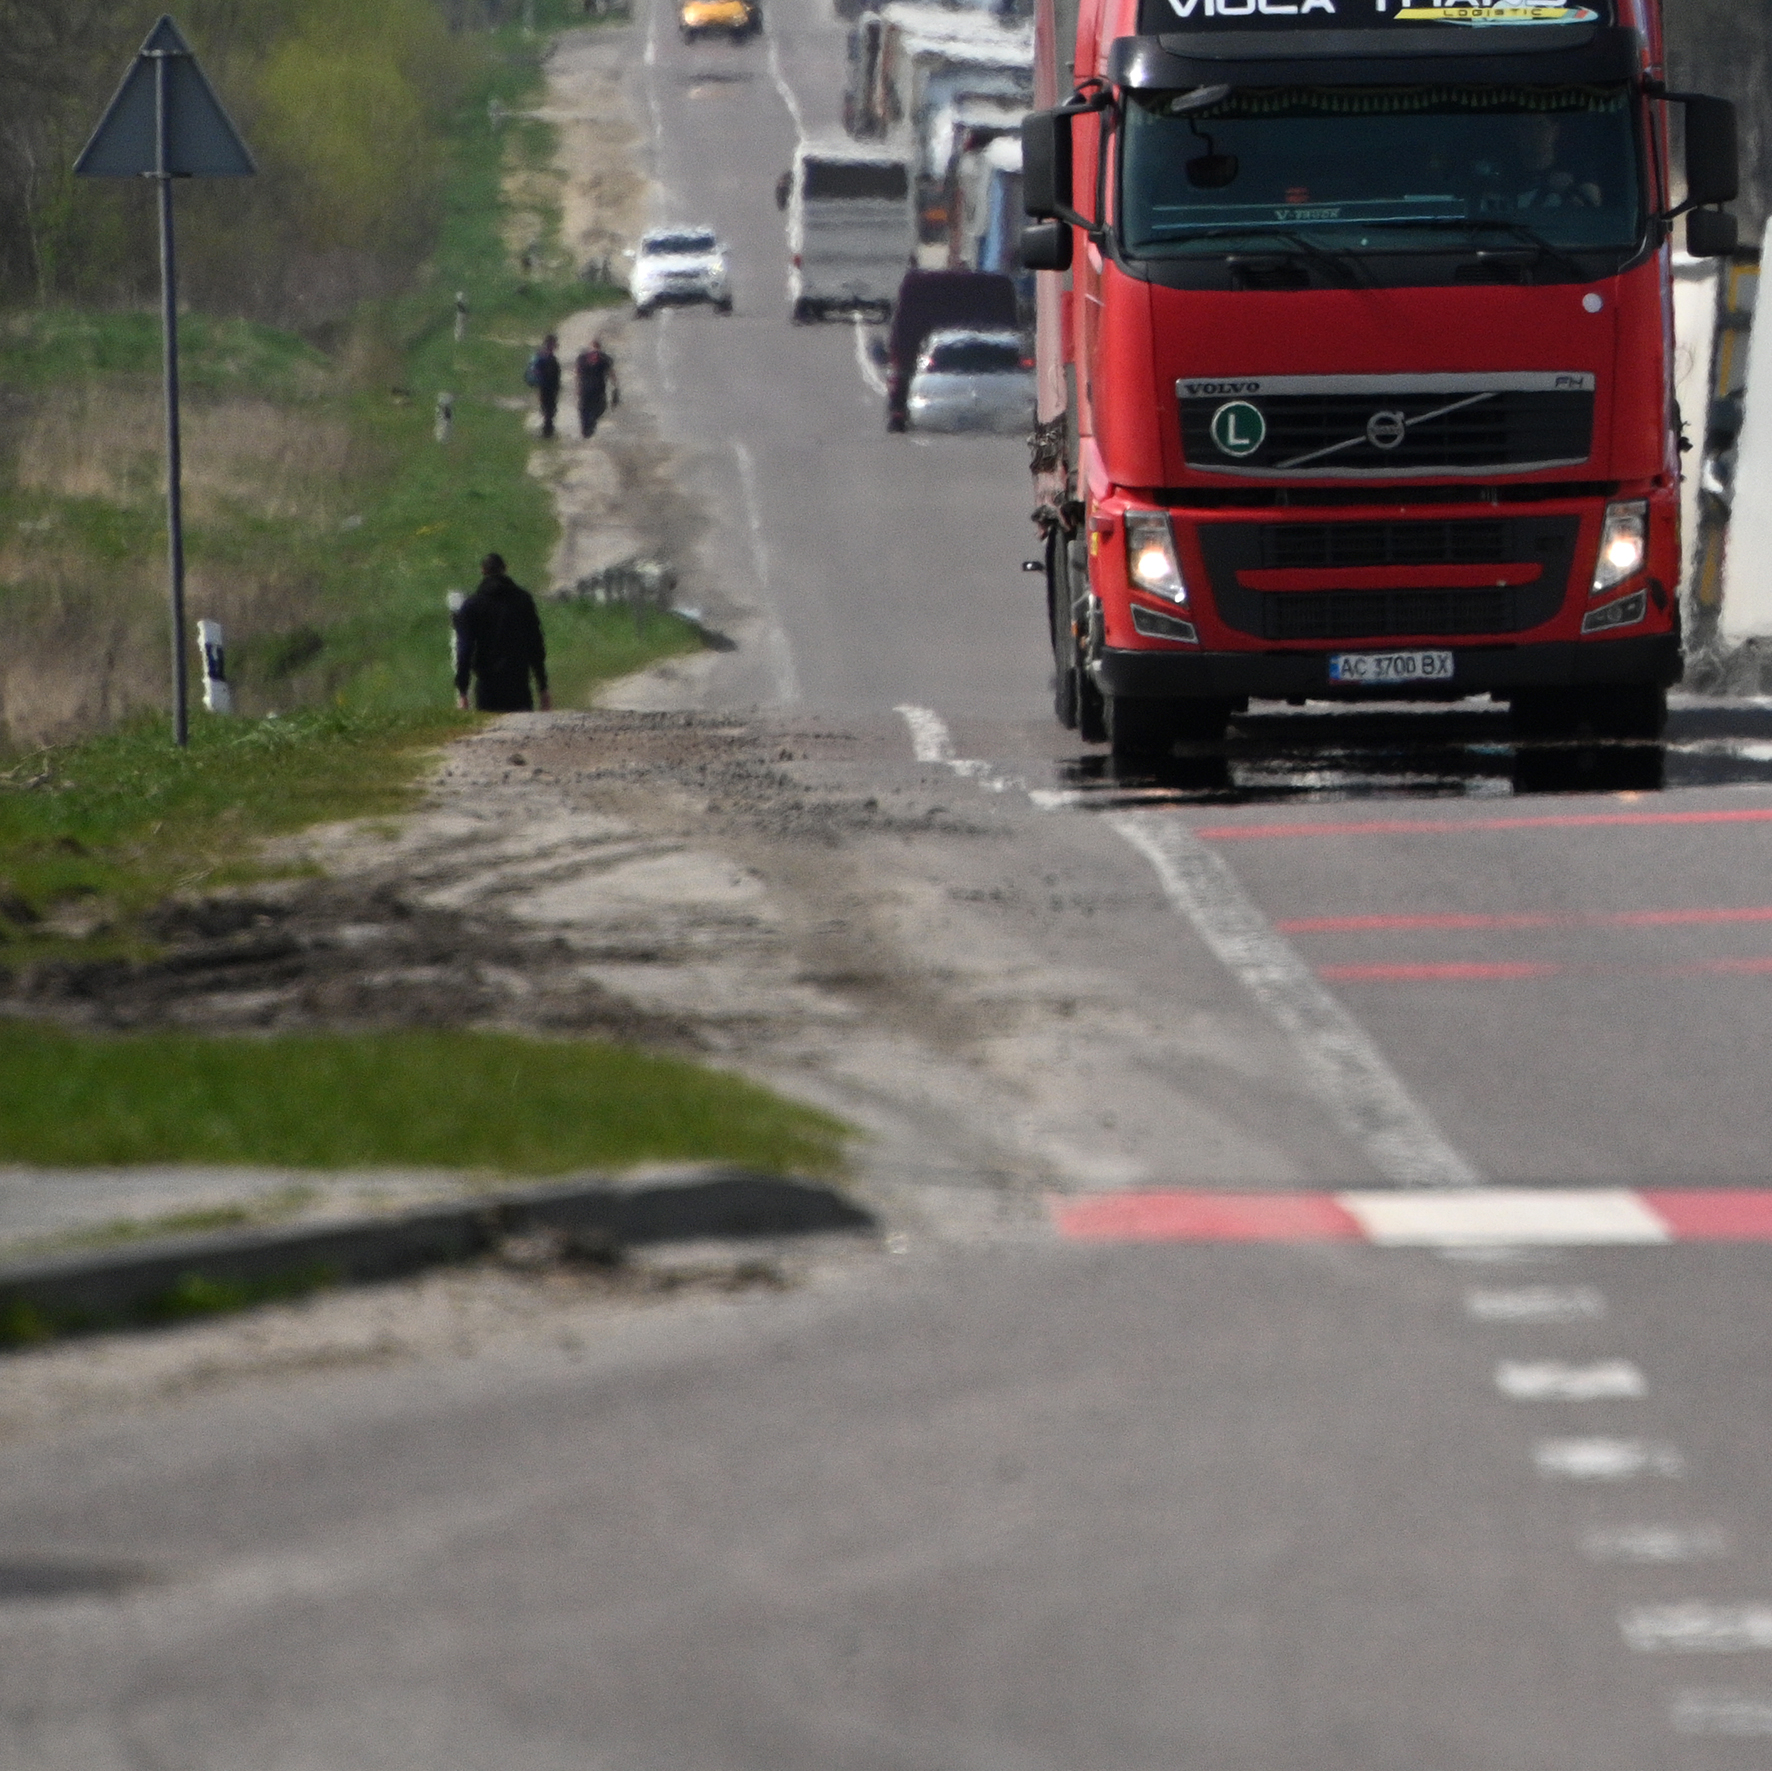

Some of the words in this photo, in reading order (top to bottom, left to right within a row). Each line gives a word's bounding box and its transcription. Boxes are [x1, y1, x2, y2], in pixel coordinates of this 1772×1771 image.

[1443, 7, 1543, 18] LOGISTIC
[1184, 382, 1260, 395] VOLVO
[1555, 376, 1584, 388] FH
[1228, 413, 1250, 445] L
[1340, 657, 1367, 678] AC
[1421, 653, 1449, 675] BX
